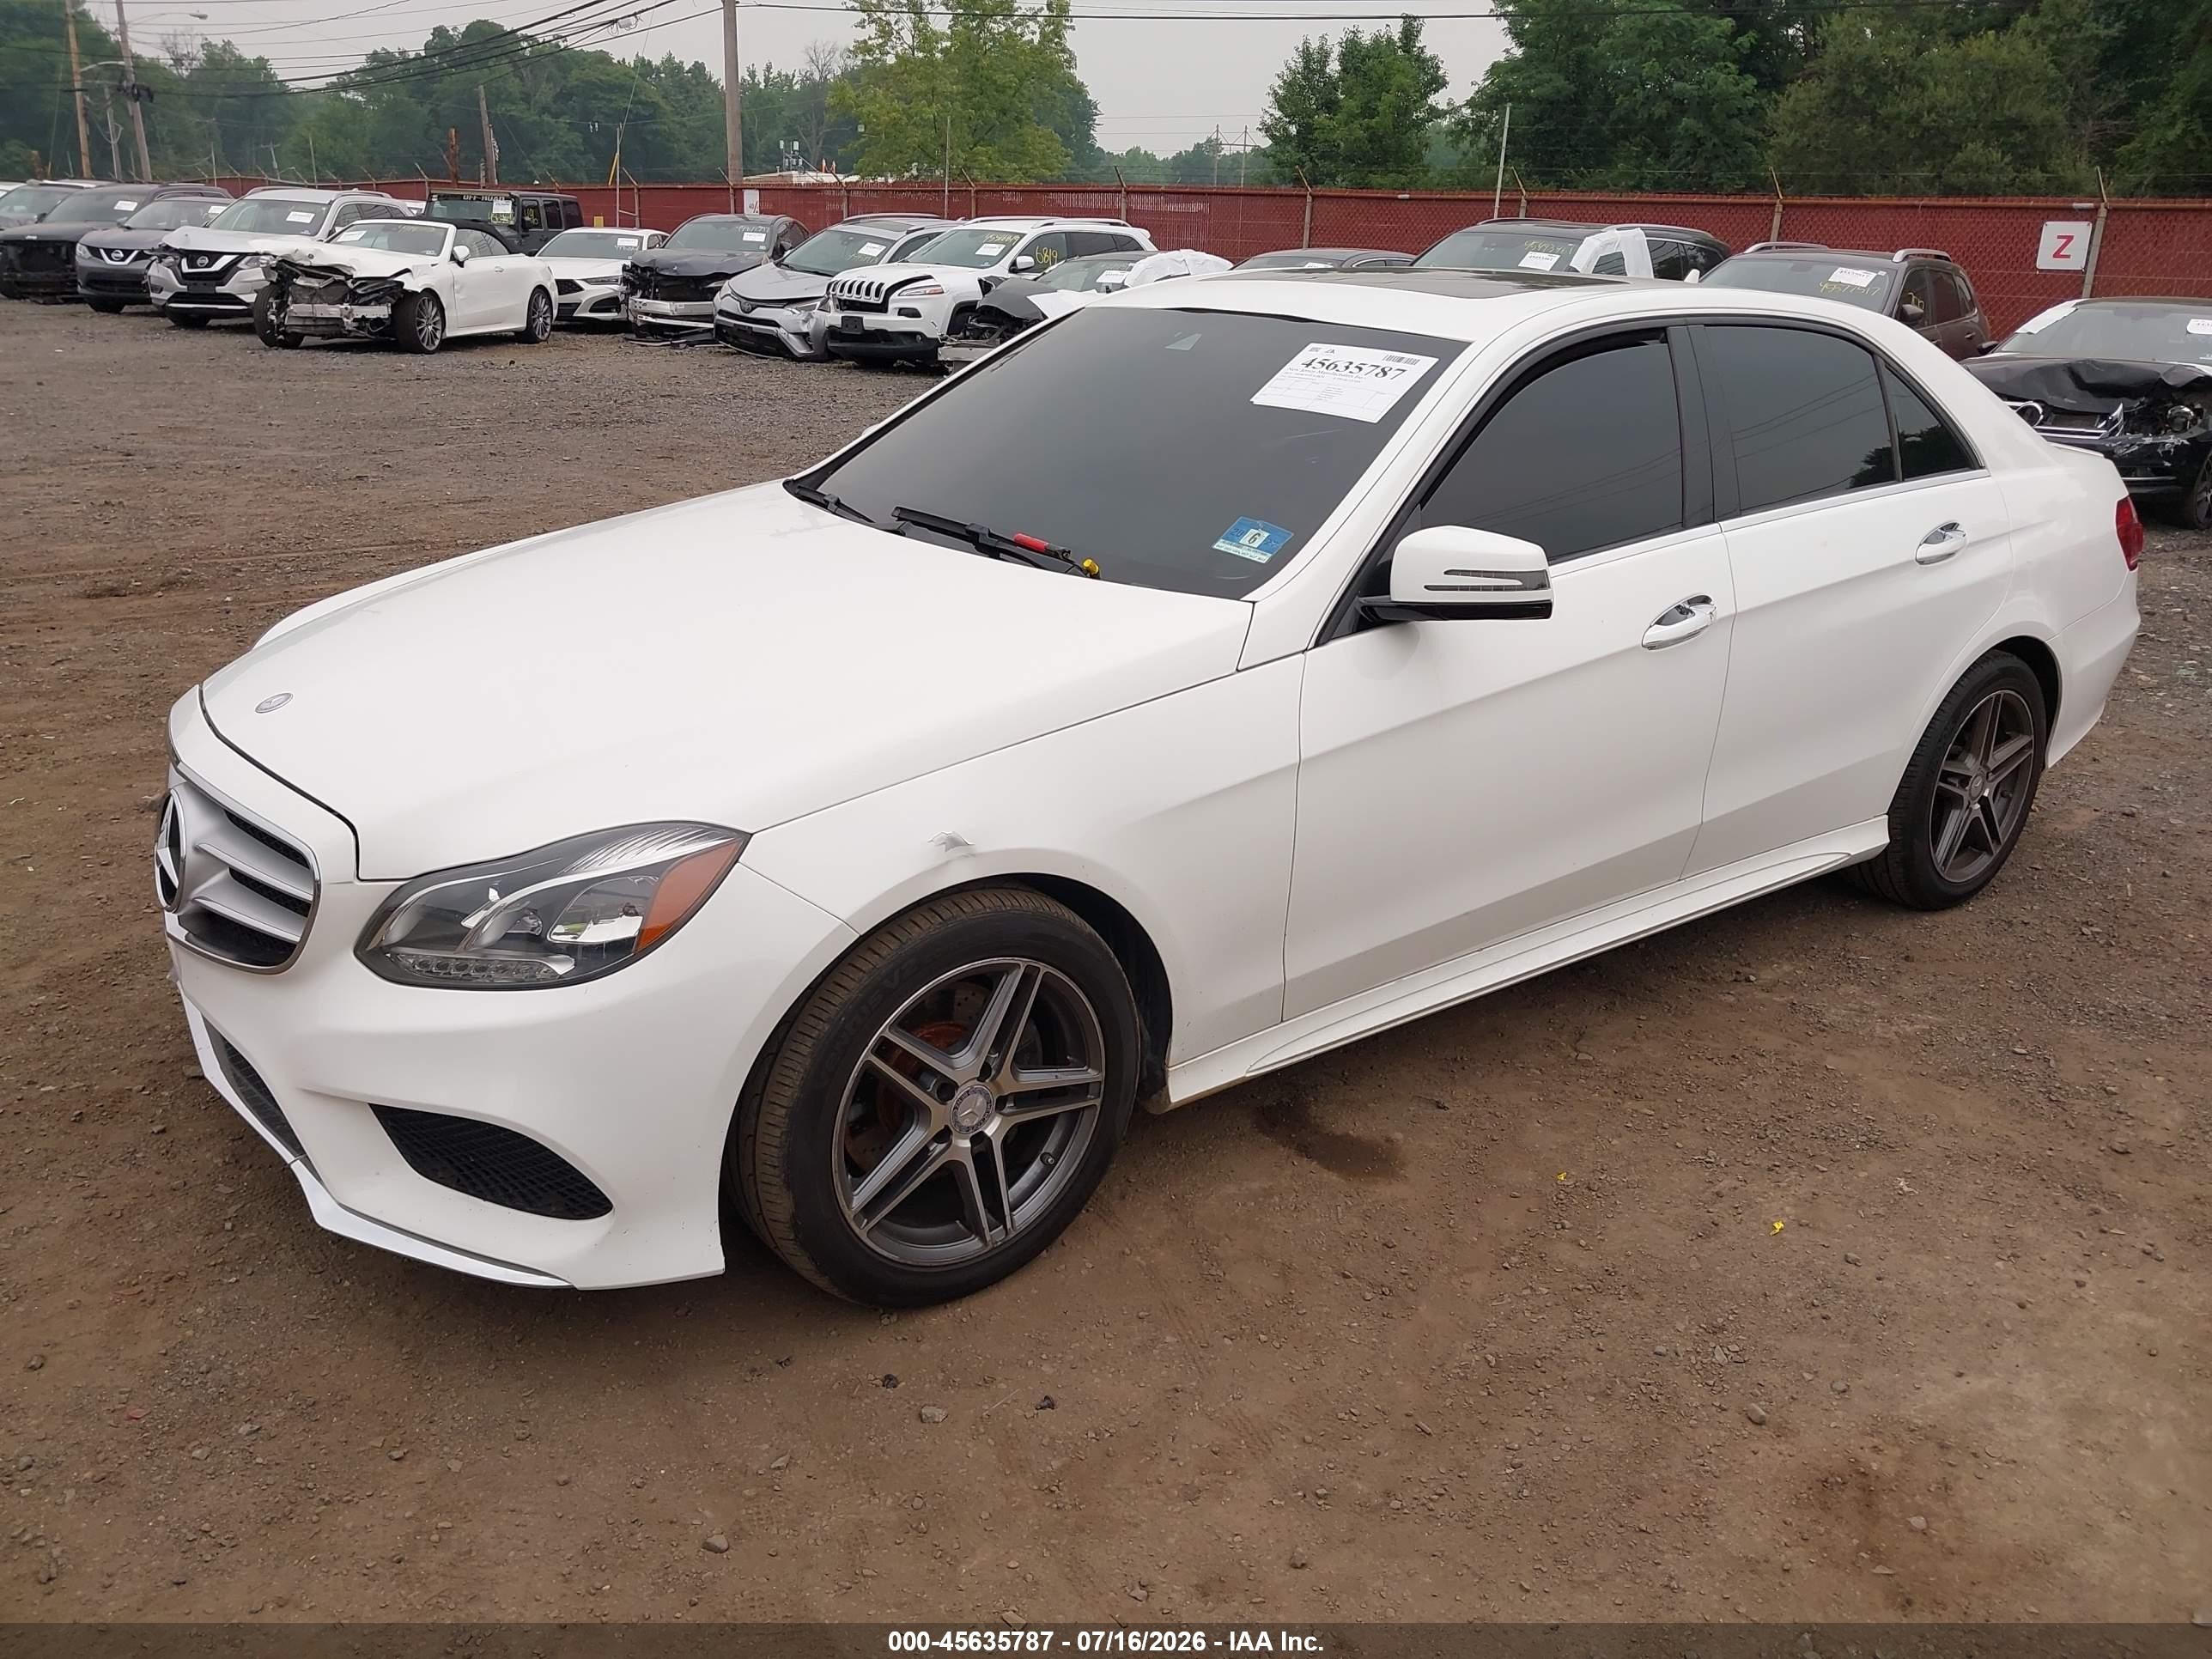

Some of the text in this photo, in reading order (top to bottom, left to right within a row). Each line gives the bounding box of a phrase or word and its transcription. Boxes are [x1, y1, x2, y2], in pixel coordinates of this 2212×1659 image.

[1036, 246, 1058, 265] 6819
[2052, 234, 2075, 258] Z
[1302, 357, 1407, 380] 45635787
[1249, 532, 1261, 544] 6
